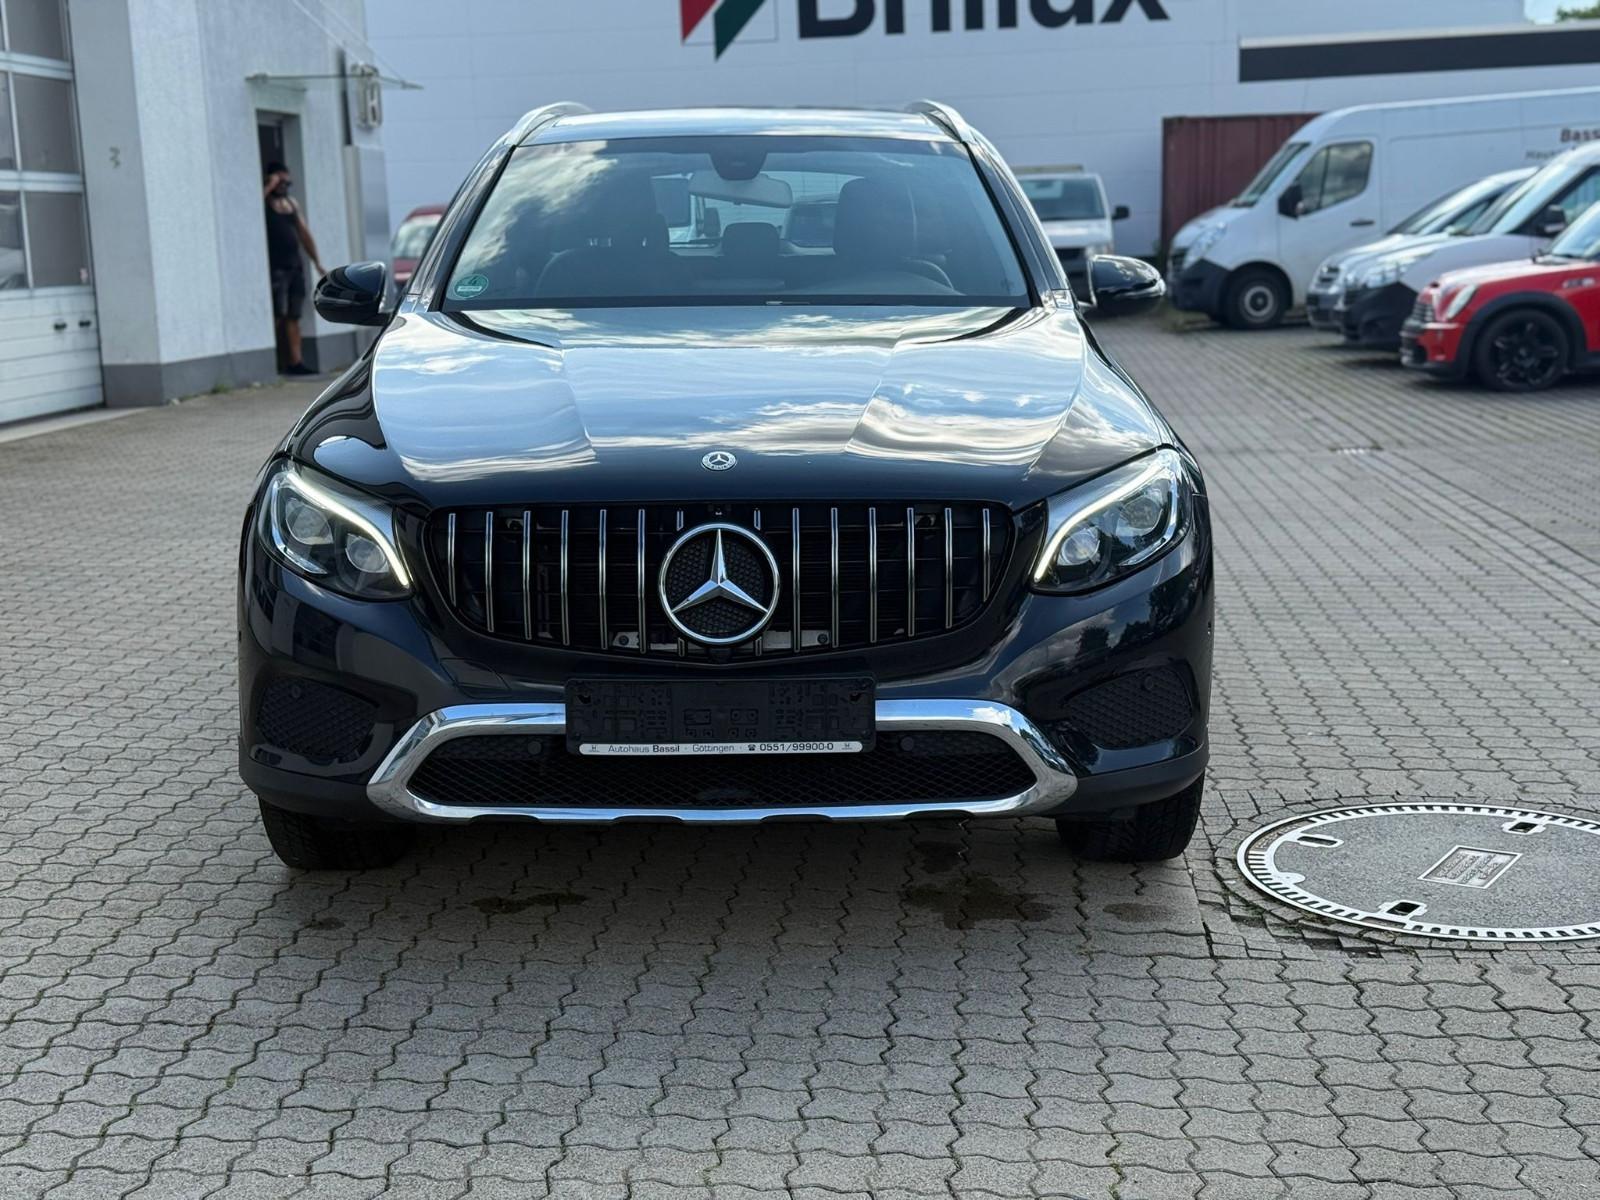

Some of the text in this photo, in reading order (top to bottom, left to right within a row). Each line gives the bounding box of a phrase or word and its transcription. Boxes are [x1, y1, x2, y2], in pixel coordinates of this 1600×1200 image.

[608, 744, 650, 753] Autohaus
[652, 744, 680, 753] Bassil
[760, 742, 834, 752] 0551/99900-0
